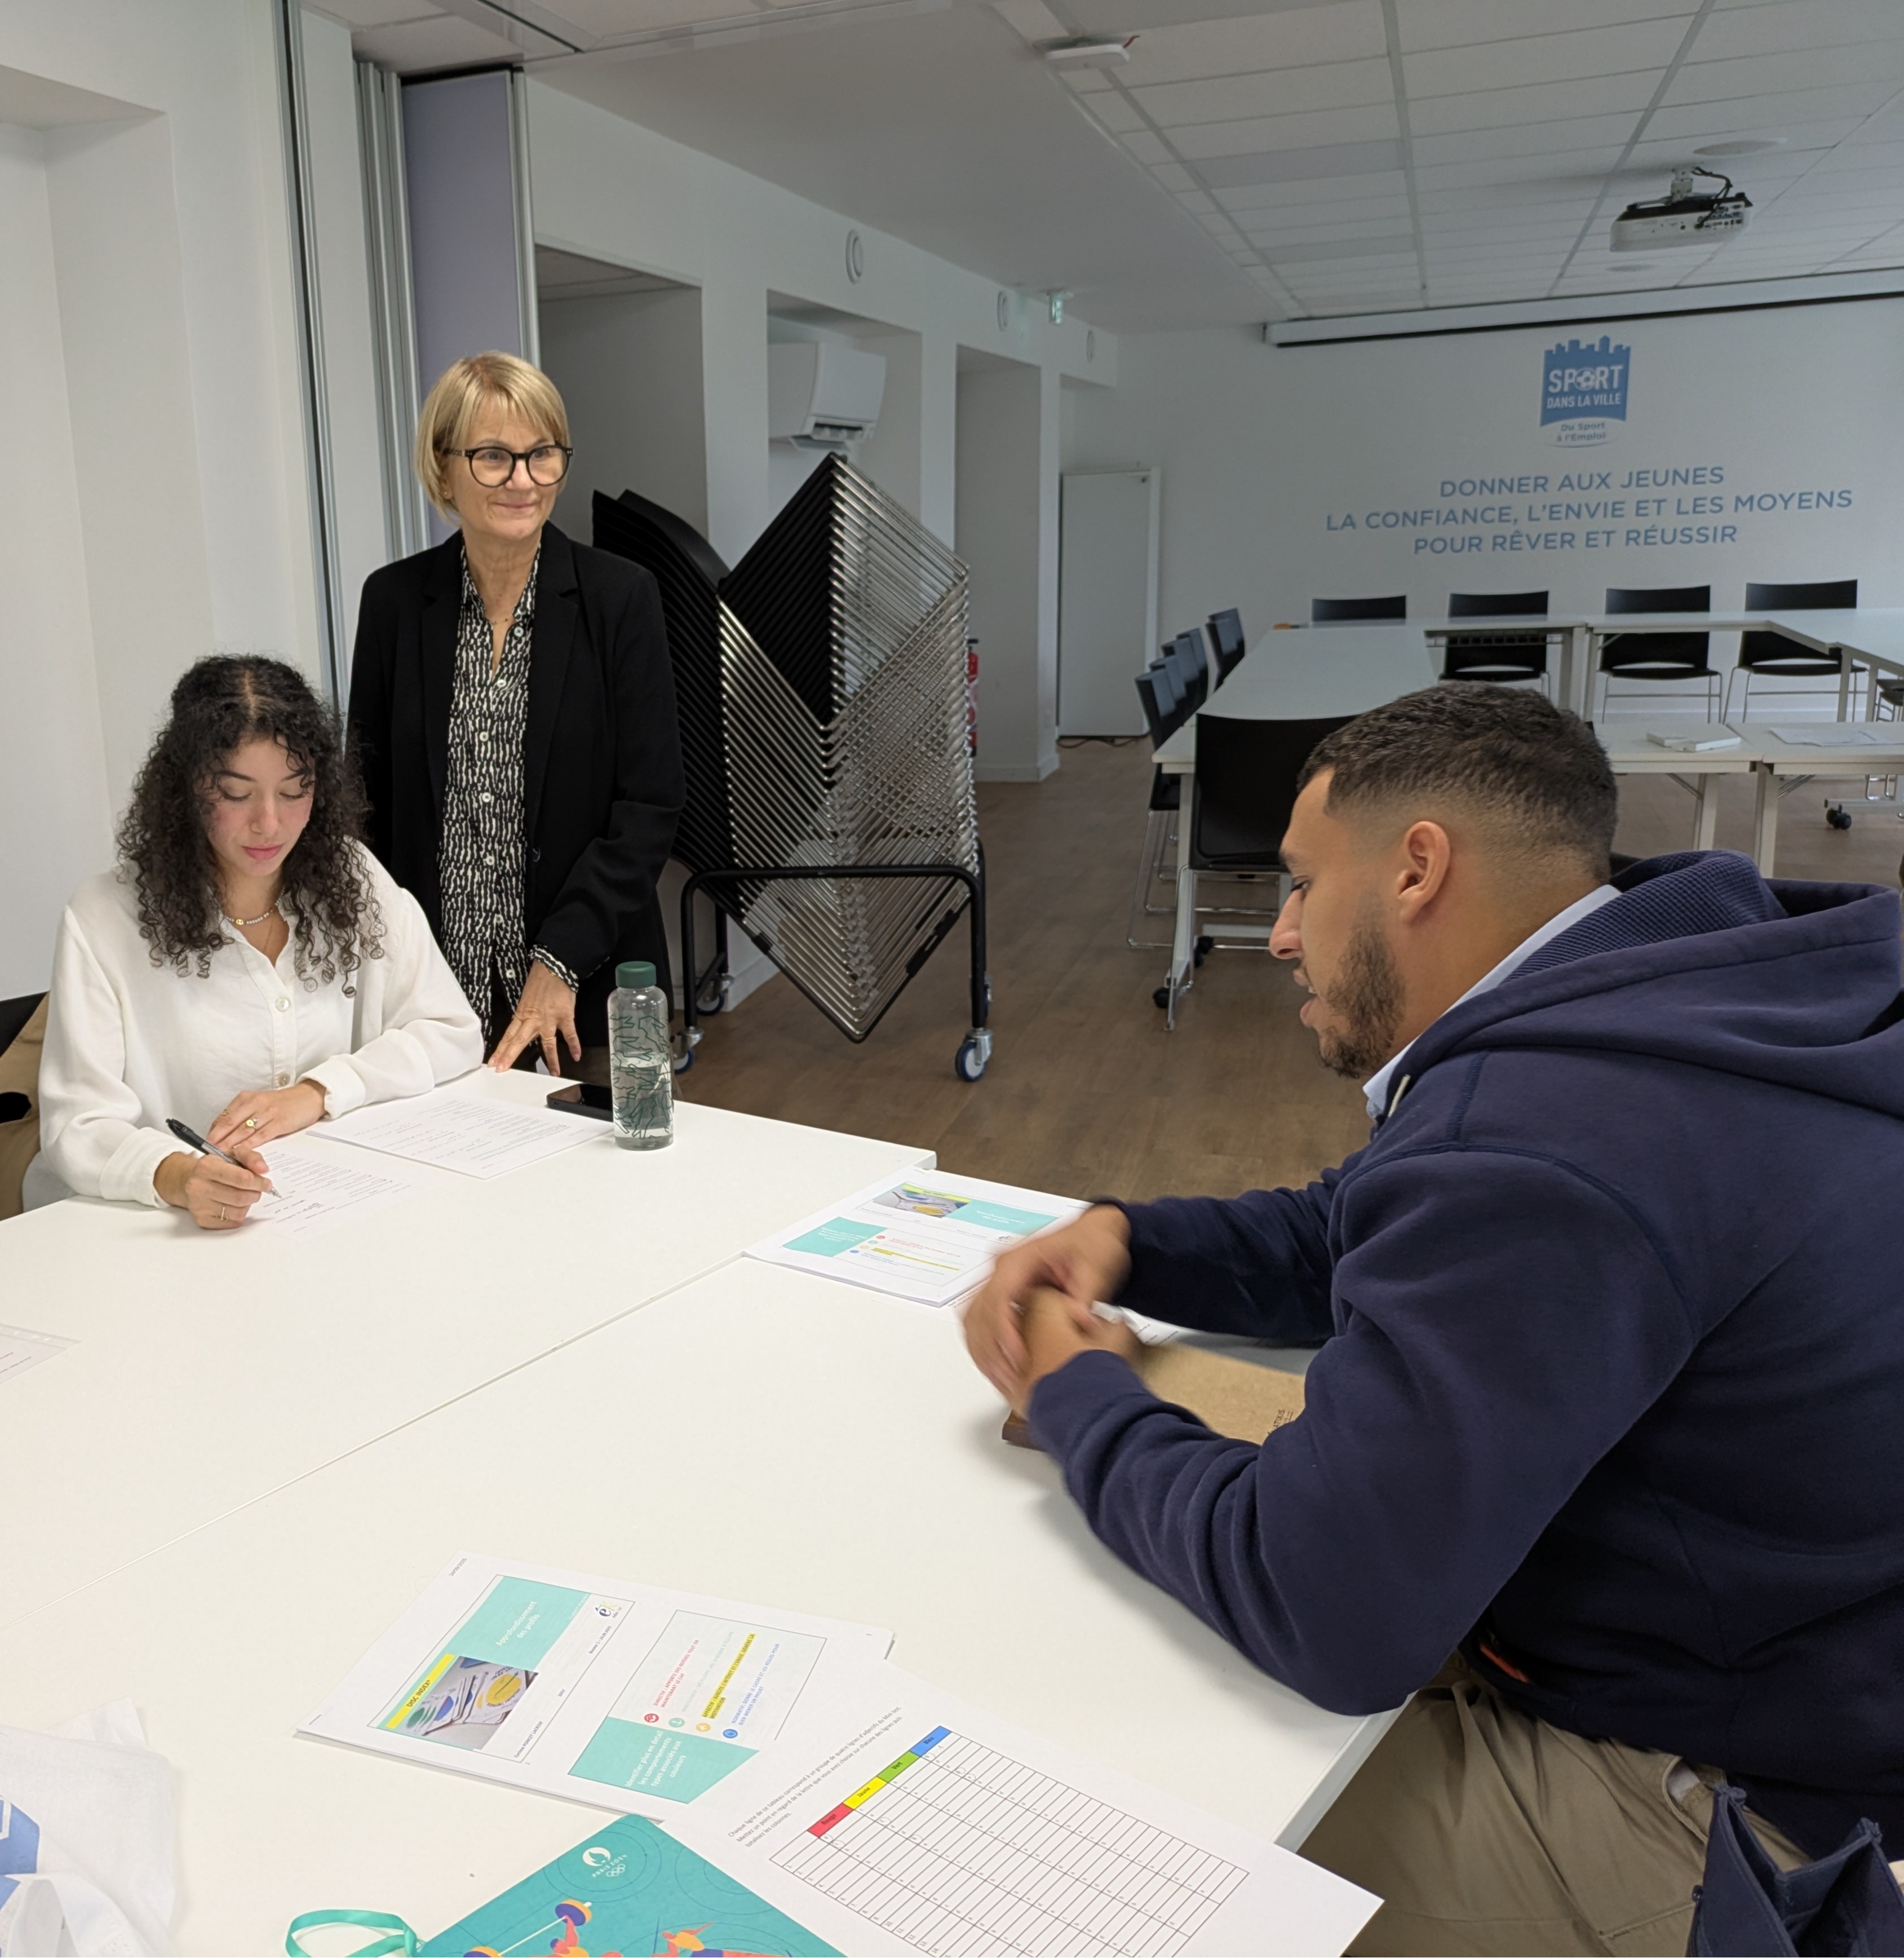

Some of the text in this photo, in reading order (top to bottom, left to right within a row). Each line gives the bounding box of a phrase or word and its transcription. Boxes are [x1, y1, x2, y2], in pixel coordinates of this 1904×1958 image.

[1548, 364, 1623, 393] SPORT
[1547, 393, 1621, 409] DANS LA VILLE
[1561, 422, 1605, 432] Du Sport
[1565, 432, 1606, 441] l'Emploi
[1441, 466, 1724, 497] DONNER AUX JEUNES
[1326, 489, 1852, 531] LA CONFIANCE, L'ENVIE ET LES MOYENS
[1414, 524, 1737, 555] POUR RÊVER ET RÉUSSIR
[496, 1601, 536, 1645] Approfondissement
[525, 1615, 539, 1629] profils
[406, 1696, 418, 1707] DISC
[625, 1763, 643, 1786] Identifier
[641, 1752, 650, 1763] plus
[645, 1738, 671, 1776] comportements
[651, 1740, 681, 1785] types associés aux
[670, 1755, 685, 1776] couleurs
[821, 1814, 836, 1824] Rouge
[856, 1785, 870, 1797] Jaune
[592, 1854, 627, 1877] PARIS 2024
